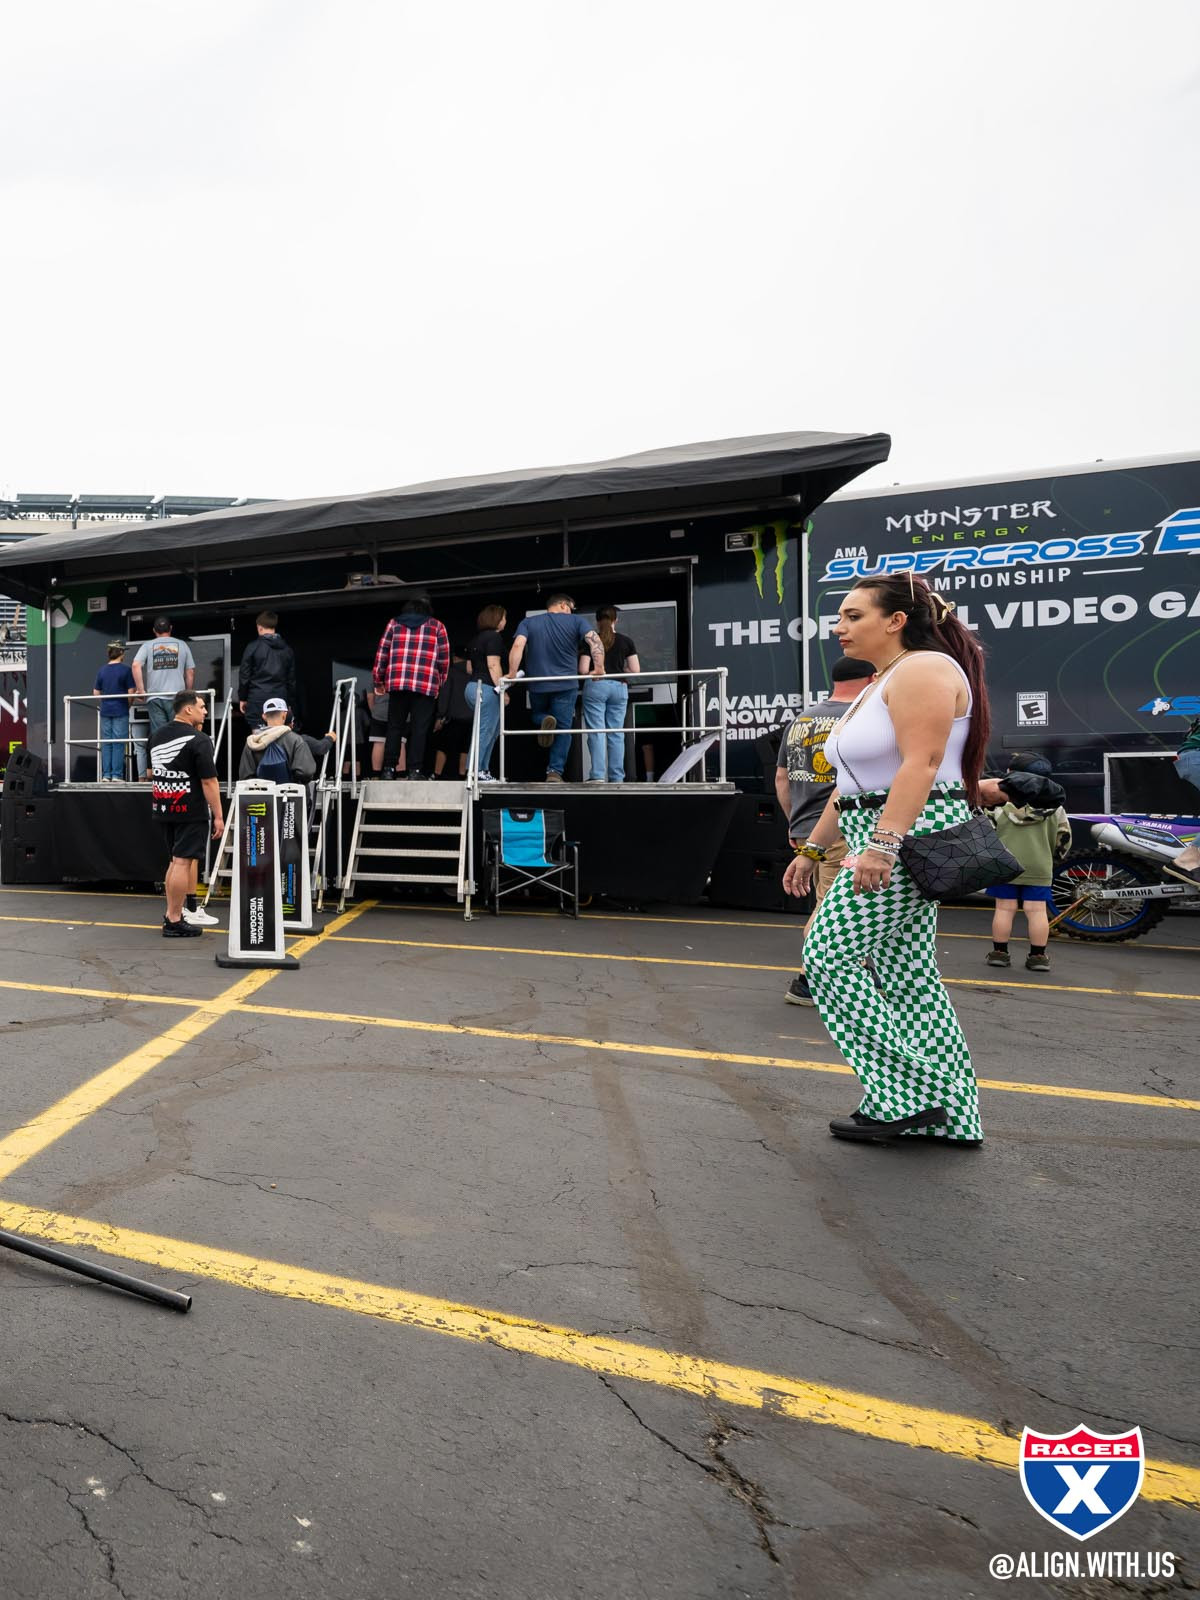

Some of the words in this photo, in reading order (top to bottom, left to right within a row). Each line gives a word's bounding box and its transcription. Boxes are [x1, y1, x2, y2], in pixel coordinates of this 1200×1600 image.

[886, 500, 1056, 534] MONSTER
[912, 525, 1031, 544] ENERGY
[818, 530, 1153, 582] SUPERCROSS
[834, 546, 867, 559] AMA
[923, 568, 1071, 592] MPIONSHIP
[984, 594, 1138, 630] VIDEO
[708, 619, 781, 647] THE
[725, 709, 777, 724] NOW
[1021, 701, 1044, 719] E
[170, 804, 187, 812] FOX
[1141, 821, 1172, 830] YAMAHA
[1116, 889, 1153, 897] YAMAHA
